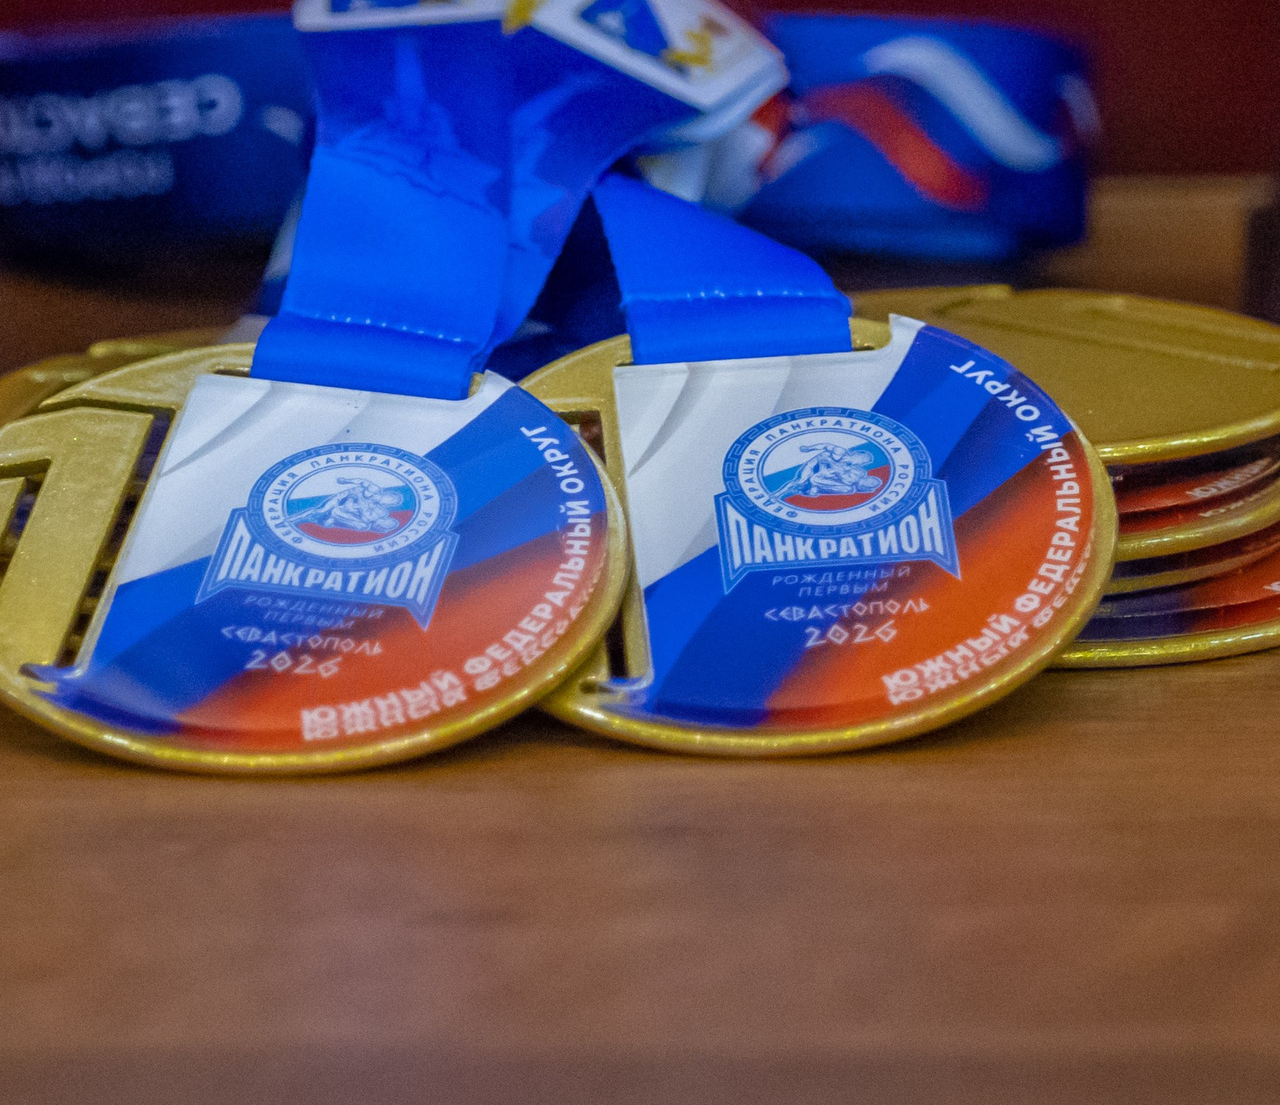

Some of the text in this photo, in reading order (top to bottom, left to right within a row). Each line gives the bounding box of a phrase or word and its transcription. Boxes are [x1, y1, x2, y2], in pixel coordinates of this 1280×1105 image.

[520, 426, 584, 494] ОКРУГ
[742, 419, 909, 518] ФЕДЕРАЦИЯ ПАНКРАТИОНА РОССИИ
[269, 454, 433, 553] ФЕДЕРАЦИЯ ПАНКРАТИОНА РОССИИ
[726, 486, 944, 570] ПАНКРАТИОН
[881, 360, 1081, 693] ЮЖНЫЙ ФЕДЕРАЛЬНЫЙ ОКРУГ
[216, 515, 446, 606] ПАНКРАТИОН
[464, 500, 591, 675] ФЕДЕРАЛЬНЫЙ
[772, 566, 911, 585] РОЖДЕННЫЙ
[798, 582, 888, 597] ПЕРВЫМ
[221, 626, 383, 656] СЕВАСТОПОЛЬ
[764, 598, 930, 621] СЕВАСТОПОЛЬ
[804, 620, 898, 648] 2026
[244, 649, 343, 679] 2026
